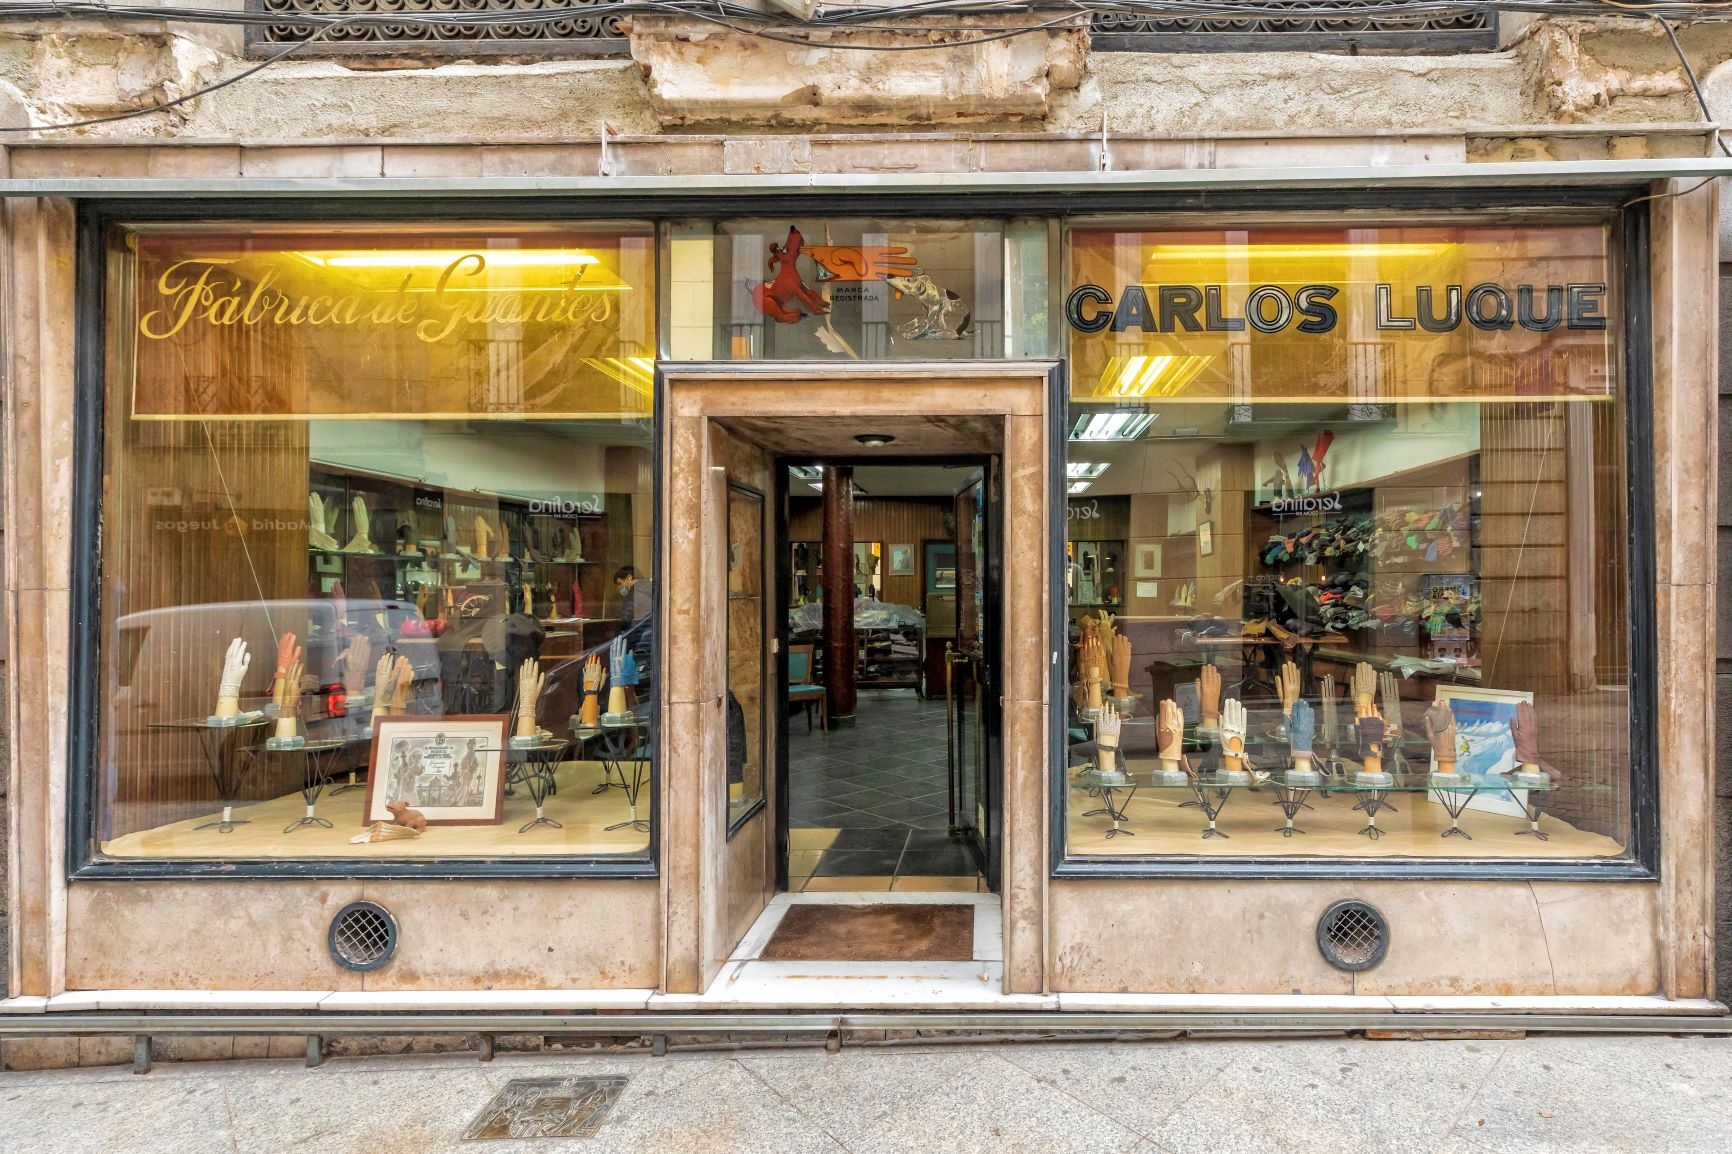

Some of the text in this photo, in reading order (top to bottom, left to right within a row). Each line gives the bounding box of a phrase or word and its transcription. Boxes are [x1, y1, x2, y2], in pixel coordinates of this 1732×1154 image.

[140, 253, 612, 343] Fábrica de Guantes
[1066, 282, 1607, 333] CARLOS LUQUE
